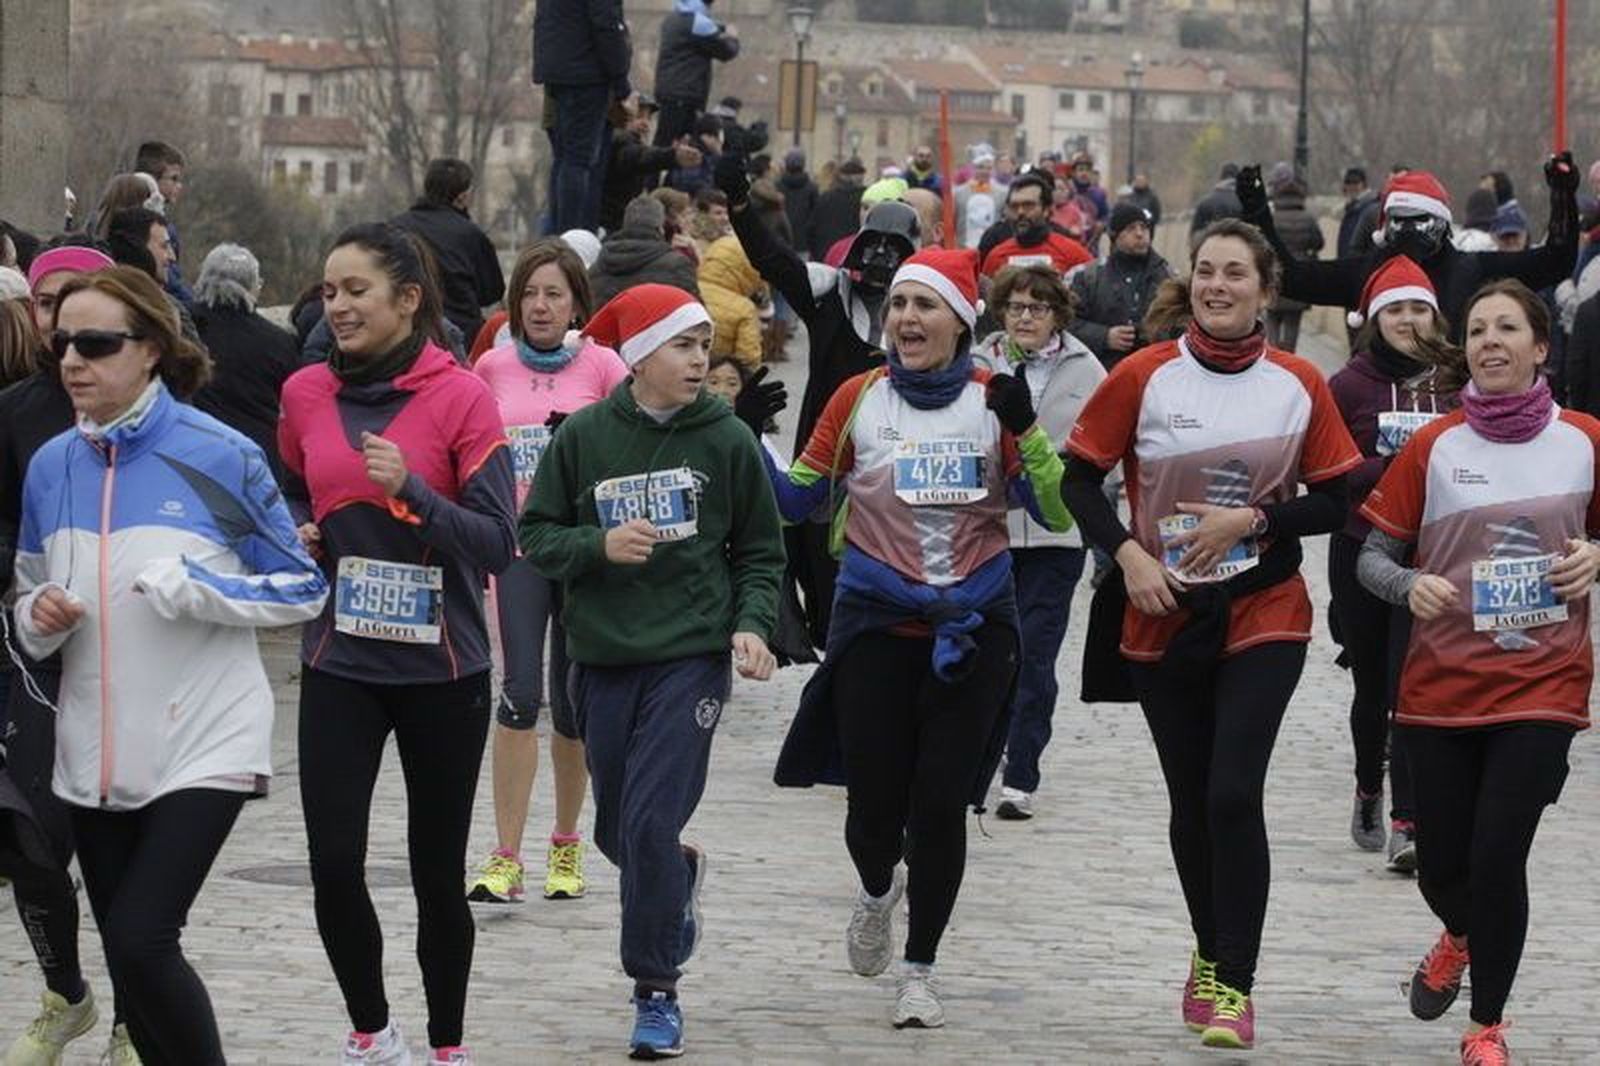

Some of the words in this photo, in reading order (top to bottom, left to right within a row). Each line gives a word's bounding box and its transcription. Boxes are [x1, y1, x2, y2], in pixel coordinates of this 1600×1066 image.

[918, 442, 979, 454] SETEL
[911, 456, 962, 484] 4123
[619, 474, 685, 493] SETEL
[366, 563, 433, 584] SETEL
[350, 579, 417, 618] 3995
[1488, 579, 1542, 608] 3213
